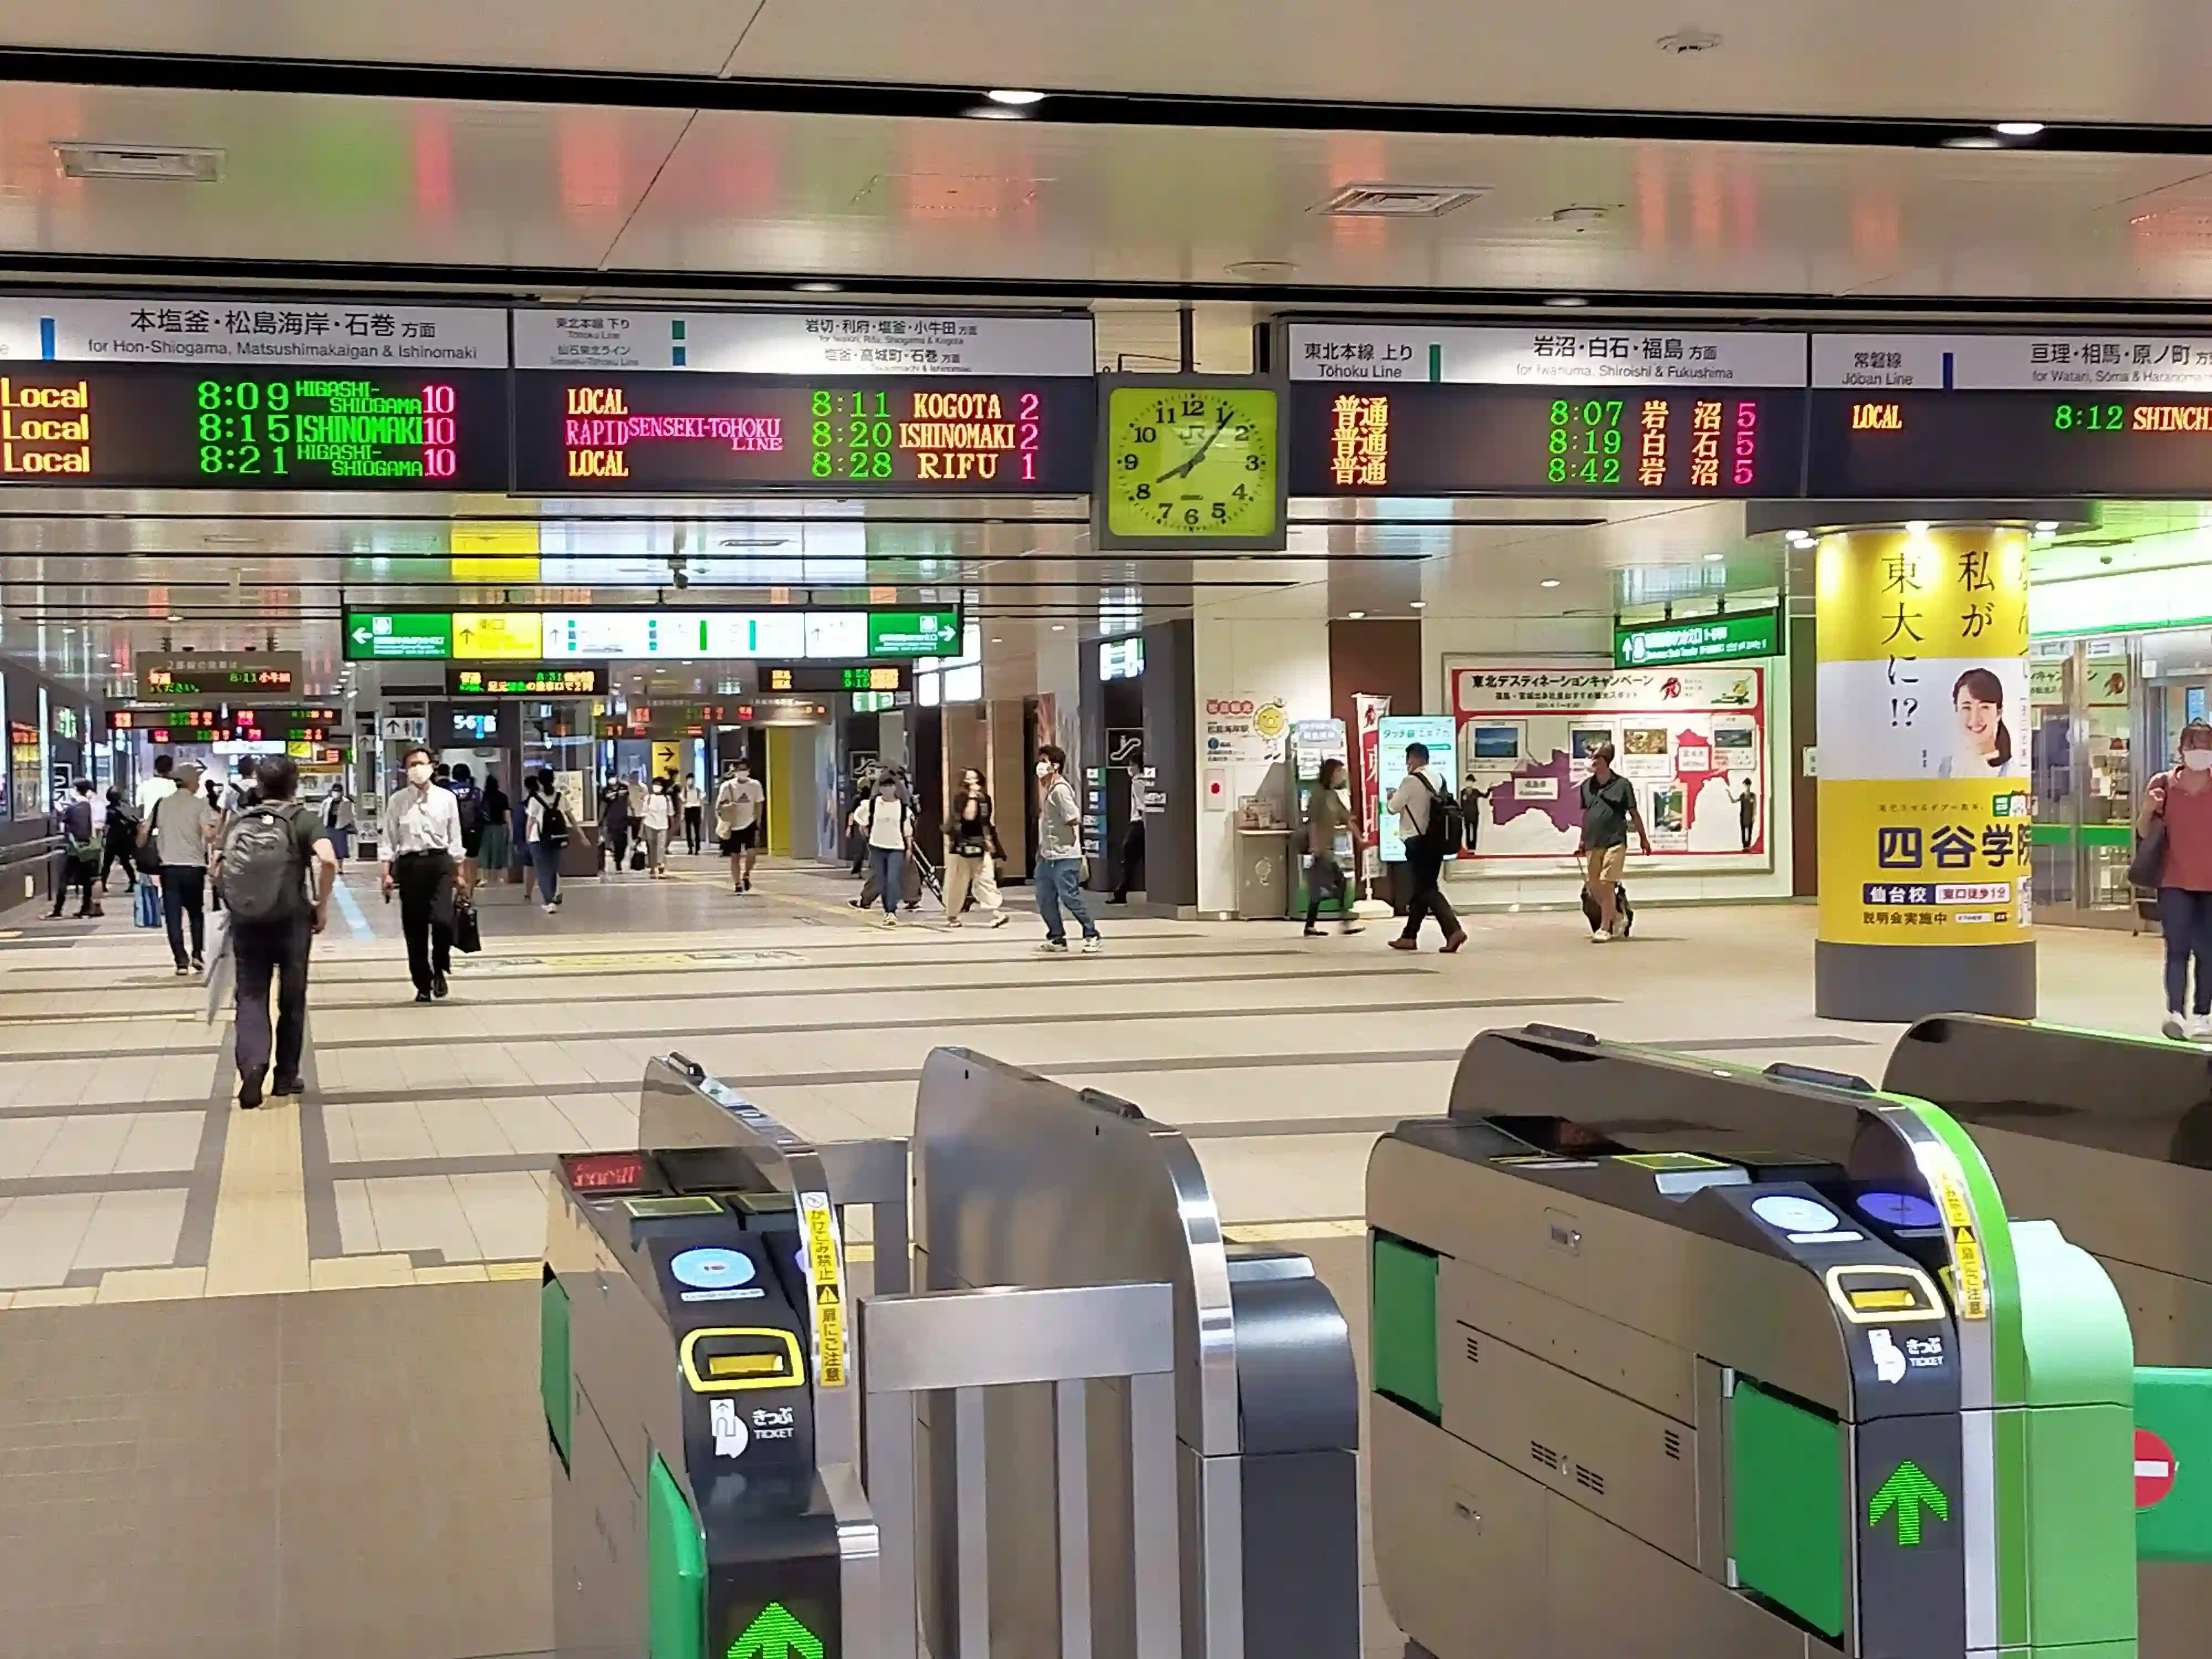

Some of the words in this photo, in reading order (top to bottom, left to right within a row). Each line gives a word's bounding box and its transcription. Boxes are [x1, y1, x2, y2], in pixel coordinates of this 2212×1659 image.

[401, 322, 435, 338] 方面
[88, 338, 108, 352] for
[114, 340, 231, 356] Hon-Shiogama,
[237, 342, 378, 359] Matsushimakaigan
[382, 346, 393, 357] &
[399, 346, 477, 359] Ishinomaki
[1304, 342, 1375, 361] 東北本線
[1382, 343, 1413, 361] 上り
[1533, 334, 1684, 360] 岩沼・白石・福島
[1688, 345, 1717, 361] 方面
[2031, 343, 2191, 365] 亘理・相馬・原ノ町
[1373, 365, 1402, 378] Line
[1599, 364, 1652, 378] Shiroishi
[1656, 366, 1663, 378] &
[1667, 365, 1734, 380] Fukushima
[1886, 372, 1913, 385] Line
[2, 377, 87, 409] Local
[198, 382, 288, 410] 8:09
[331, 398, 421, 414] SHIOGAMA
[422, 386, 455, 414] 10
[567, 388, 628, 415] LOCAL
[811, 391, 890, 418] 8:11
[913, 393, 1001, 419] KOGOTA
[1020, 393, 1040, 420] 2
[1182, 400, 1204, 416] 12
[1332, 395, 1389, 427] 普通
[1551, 400, 1623, 425] 8:07
[1738, 403, 1755, 427] 5
[1156, 408, 1175, 424] 11
[1853, 404, 1902, 429] LOCAL
[2055, 405, 2124, 430] 8:12
[3, 410, 89, 441] Local
[199, 414, 289, 443] 8:15
[297, 416, 421, 445] ISHINOMAKI
[422, 418, 455, 446] 10
[566, 419, 629, 446] RAPID
[731, 437, 783, 451] LINE
[811, 421, 892, 447] 8:20
[899, 422, 1016, 448] ISHINOMAKI
[1020, 424, 1039, 450] 2
[1134, 426, 1156, 443] 10
[1235, 425, 1249, 442] 2
[1331, 427, 1389, 456] 普通
[1549, 430, 1621, 455] 8:19
[1736, 431, 1754, 455] 5
[4, 444, 90, 473] Local
[201, 446, 288, 474] 8:21
[332, 461, 422, 476] SHIOGAMA
[425, 448, 455, 477] 10
[568, 450, 629, 477] LOCAL
[811, 451, 893, 478] 8:28
[917, 452, 999, 479] RIFU
[1022, 453, 1036, 480] 1
[1124, 453, 1138, 471] 9
[1245, 455, 1259, 471] 3
[1330, 456, 1387, 485] 普通
[1548, 458, 1620, 483] 8:42
[1734, 459, 1752, 483] 5
[1136, 483, 1151, 499] 8
[1232, 483, 1248, 500] 4
[1159, 503, 1173, 519] 7
[1185, 508, 1199, 525] 6
[1211, 503, 1225, 518] 5
[1959, 551, 1995, 638] 私が
[1472, 675, 1653, 688] 東北デスティネーションキャンペーン
[1870, 886, 1928, 904] 仙台校
[753, 1427, 795, 1439] TICKET
